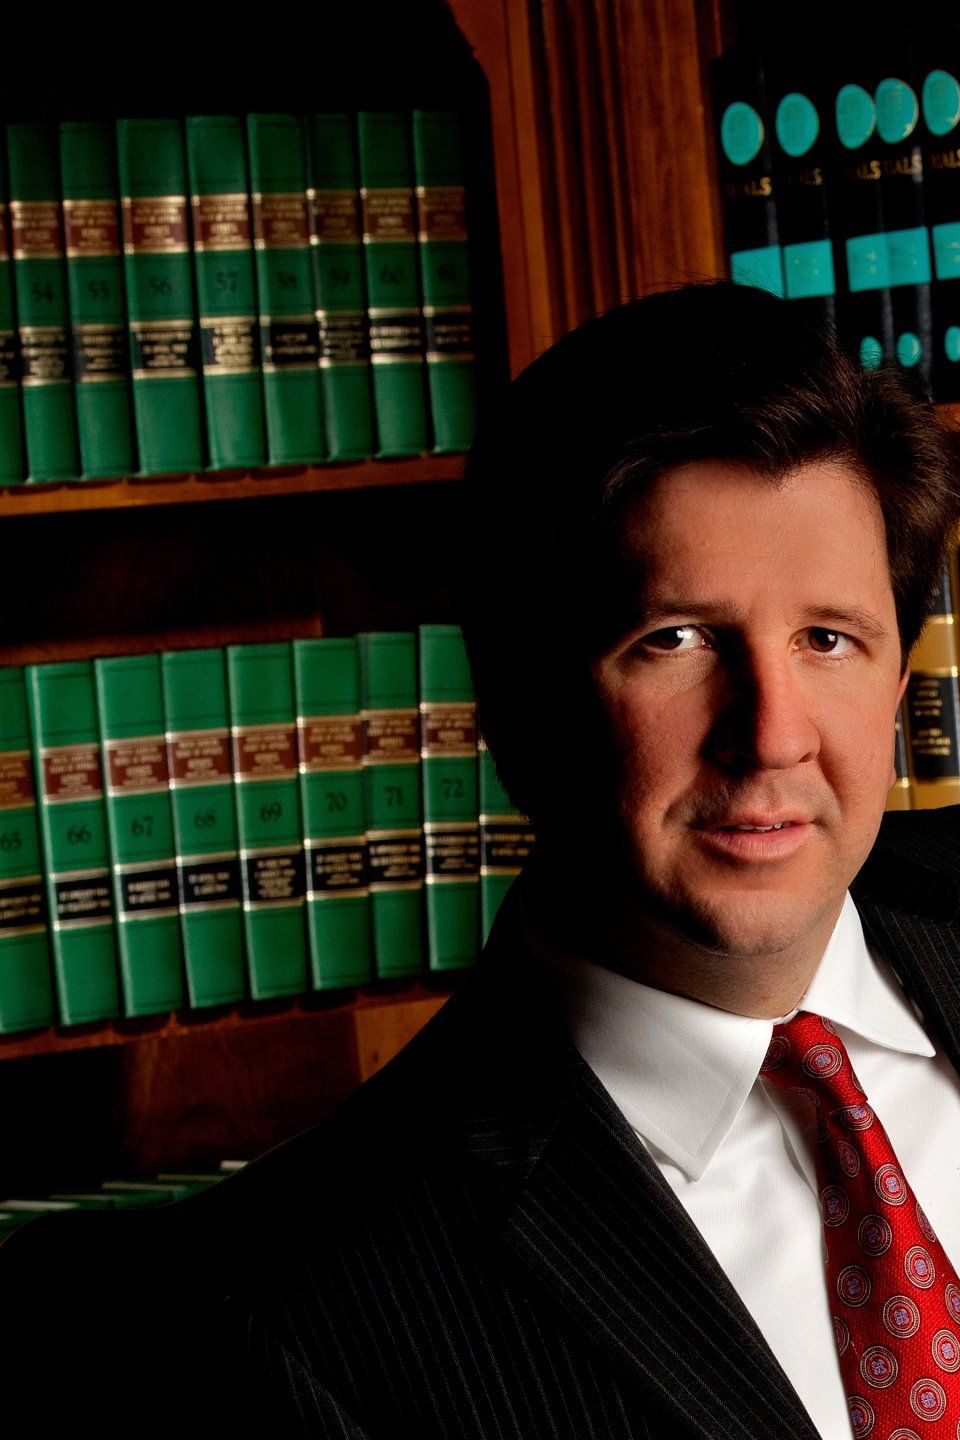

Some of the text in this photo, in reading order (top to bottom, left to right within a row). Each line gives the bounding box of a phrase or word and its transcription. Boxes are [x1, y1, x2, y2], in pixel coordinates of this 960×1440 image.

[441, 778, 464, 799] 72
[324, 792, 348, 814] 70
[131, 815, 153, 837] 67
